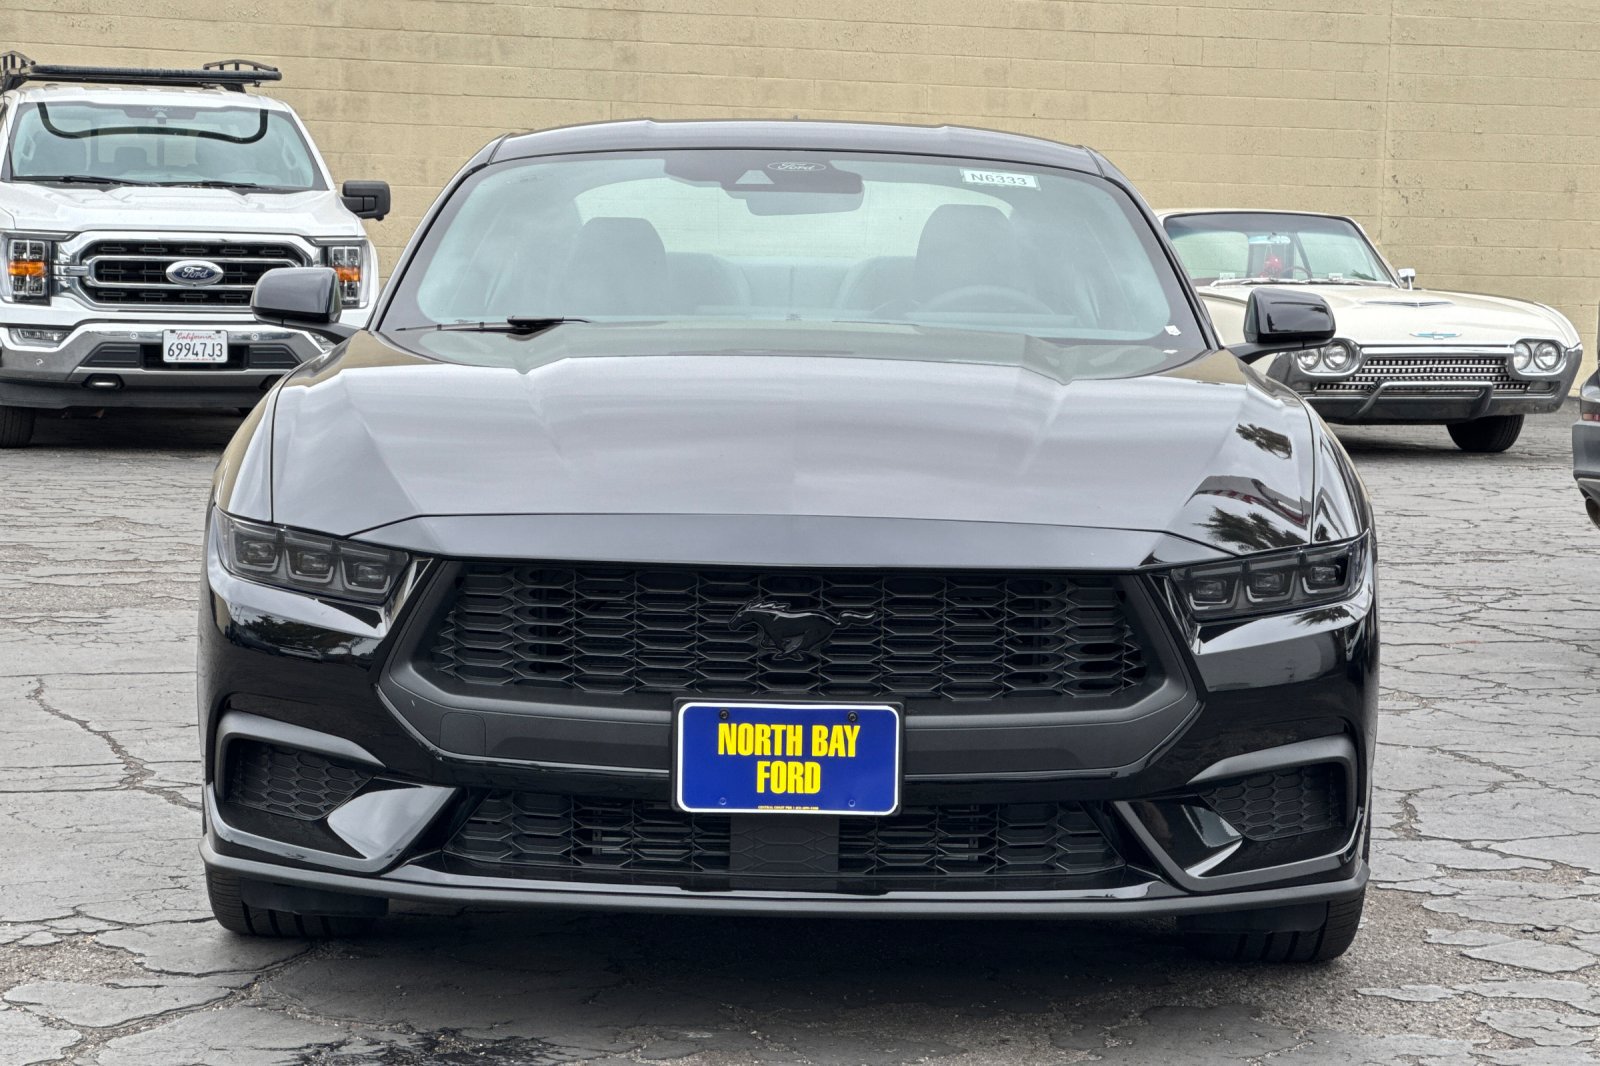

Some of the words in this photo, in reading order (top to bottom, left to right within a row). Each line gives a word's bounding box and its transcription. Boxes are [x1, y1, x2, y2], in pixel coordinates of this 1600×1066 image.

[778, 162, 815, 170] Ford
[971, 173, 1026, 185] N6333
[181, 266, 208, 278] Ford
[167, 342, 223, 357] 69947J3
[718, 723, 802, 756] NORTH
[812, 725, 861, 757] BAY
[756, 761, 821, 794] FORD
